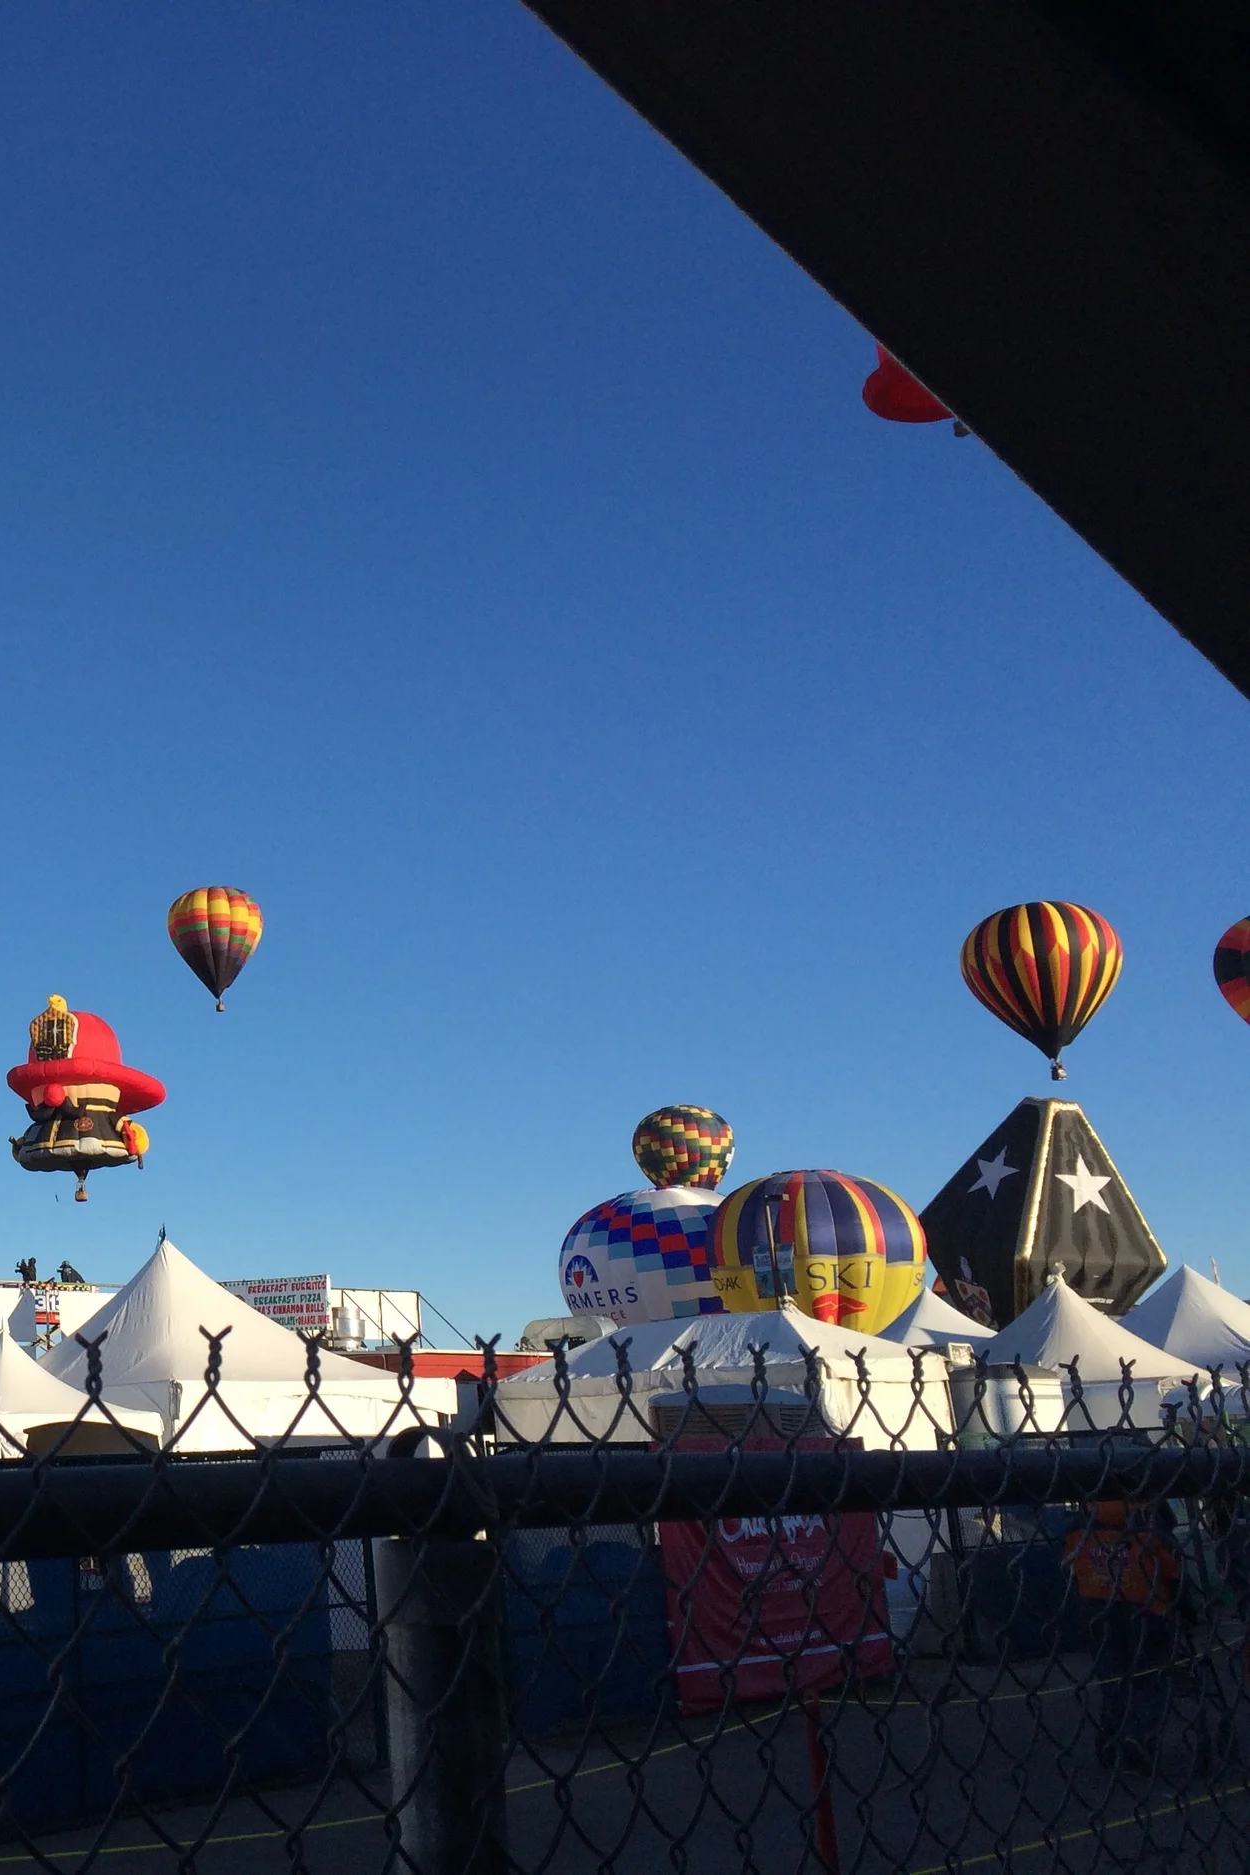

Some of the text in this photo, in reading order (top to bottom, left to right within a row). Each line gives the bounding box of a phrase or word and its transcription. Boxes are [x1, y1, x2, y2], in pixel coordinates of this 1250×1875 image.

[806, 1260, 874, 1292] SKI
[247, 1281, 327, 1294] BREAKFAST BURRITOS
[254, 1293, 321, 1305] BREAKFAST PIZZA
[565, 1286, 638, 1309] ARMERS
[306, 1303, 325, 1313] ROLLS
